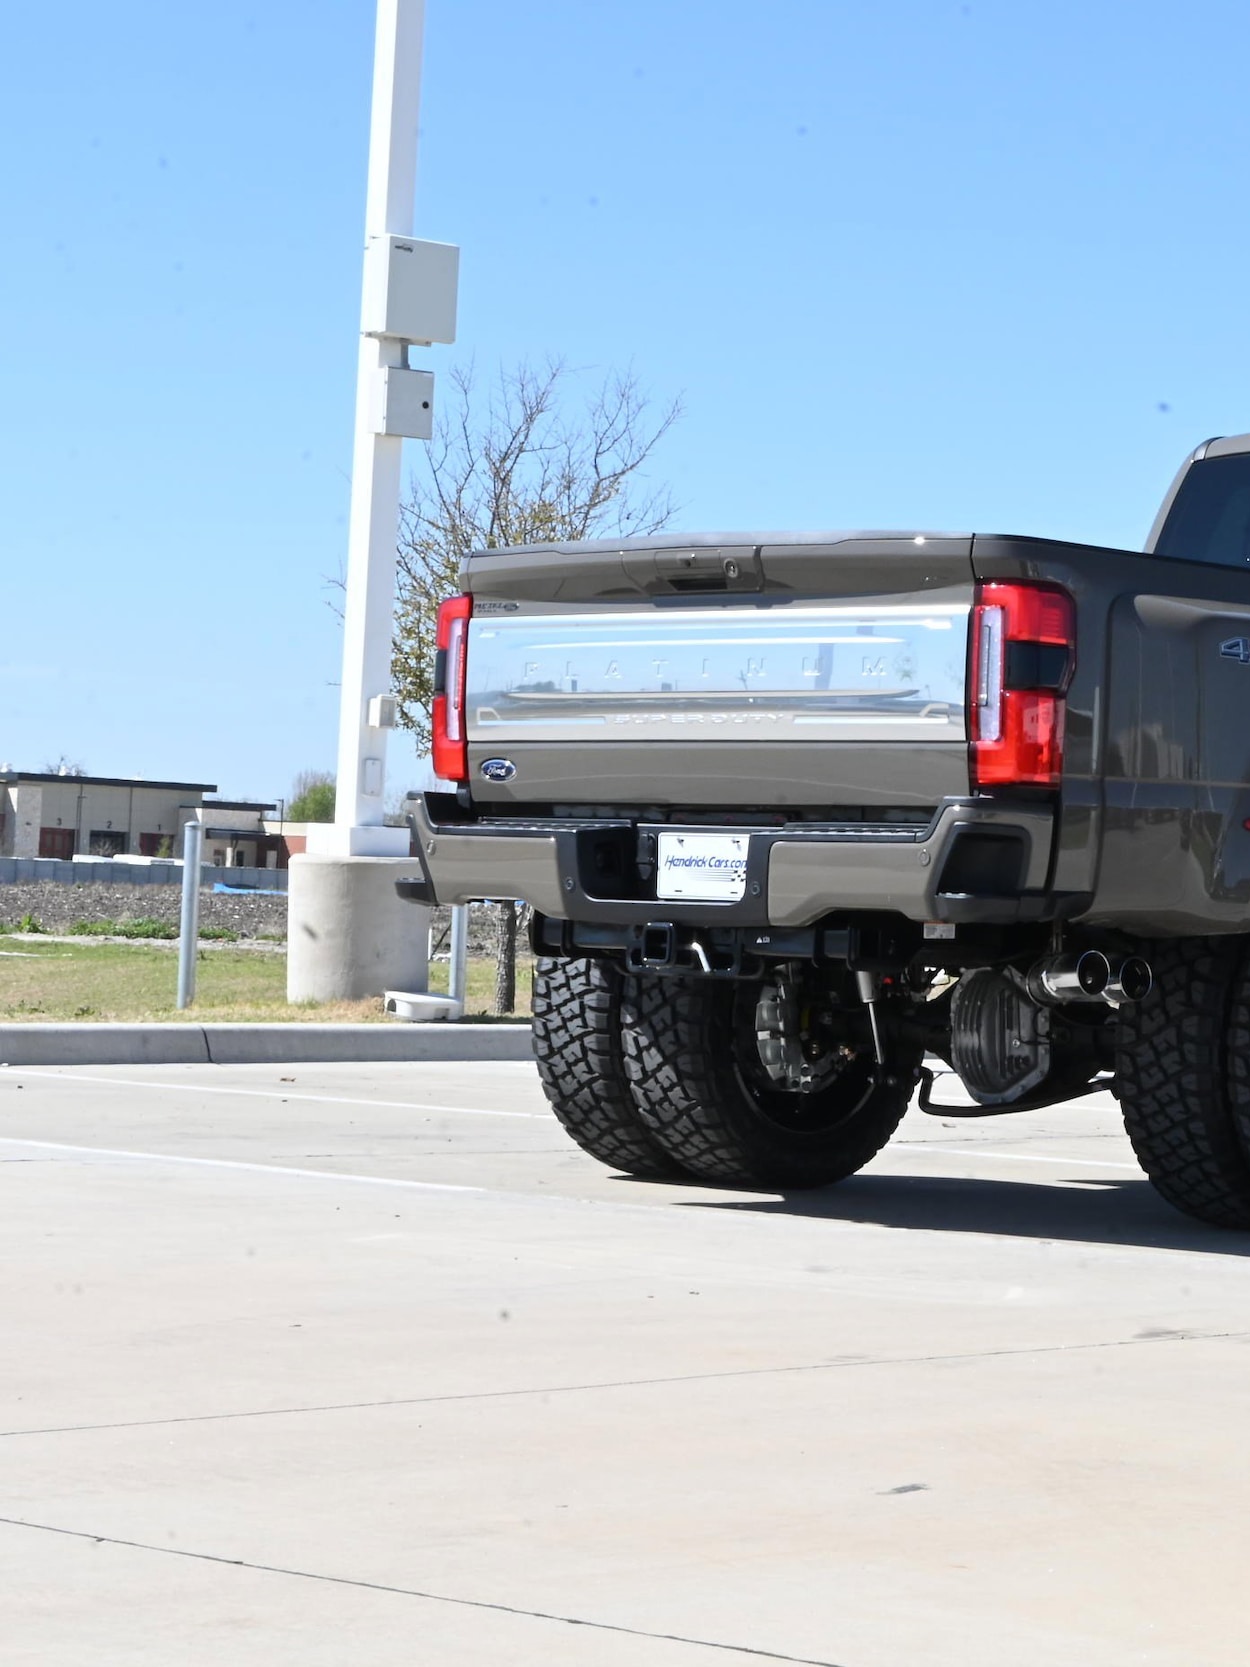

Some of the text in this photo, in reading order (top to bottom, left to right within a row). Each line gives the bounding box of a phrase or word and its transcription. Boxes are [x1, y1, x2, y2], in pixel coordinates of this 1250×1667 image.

[523, 655, 888, 680] PLATINUM
[612, 712, 784, 725] SUPER DUTY
